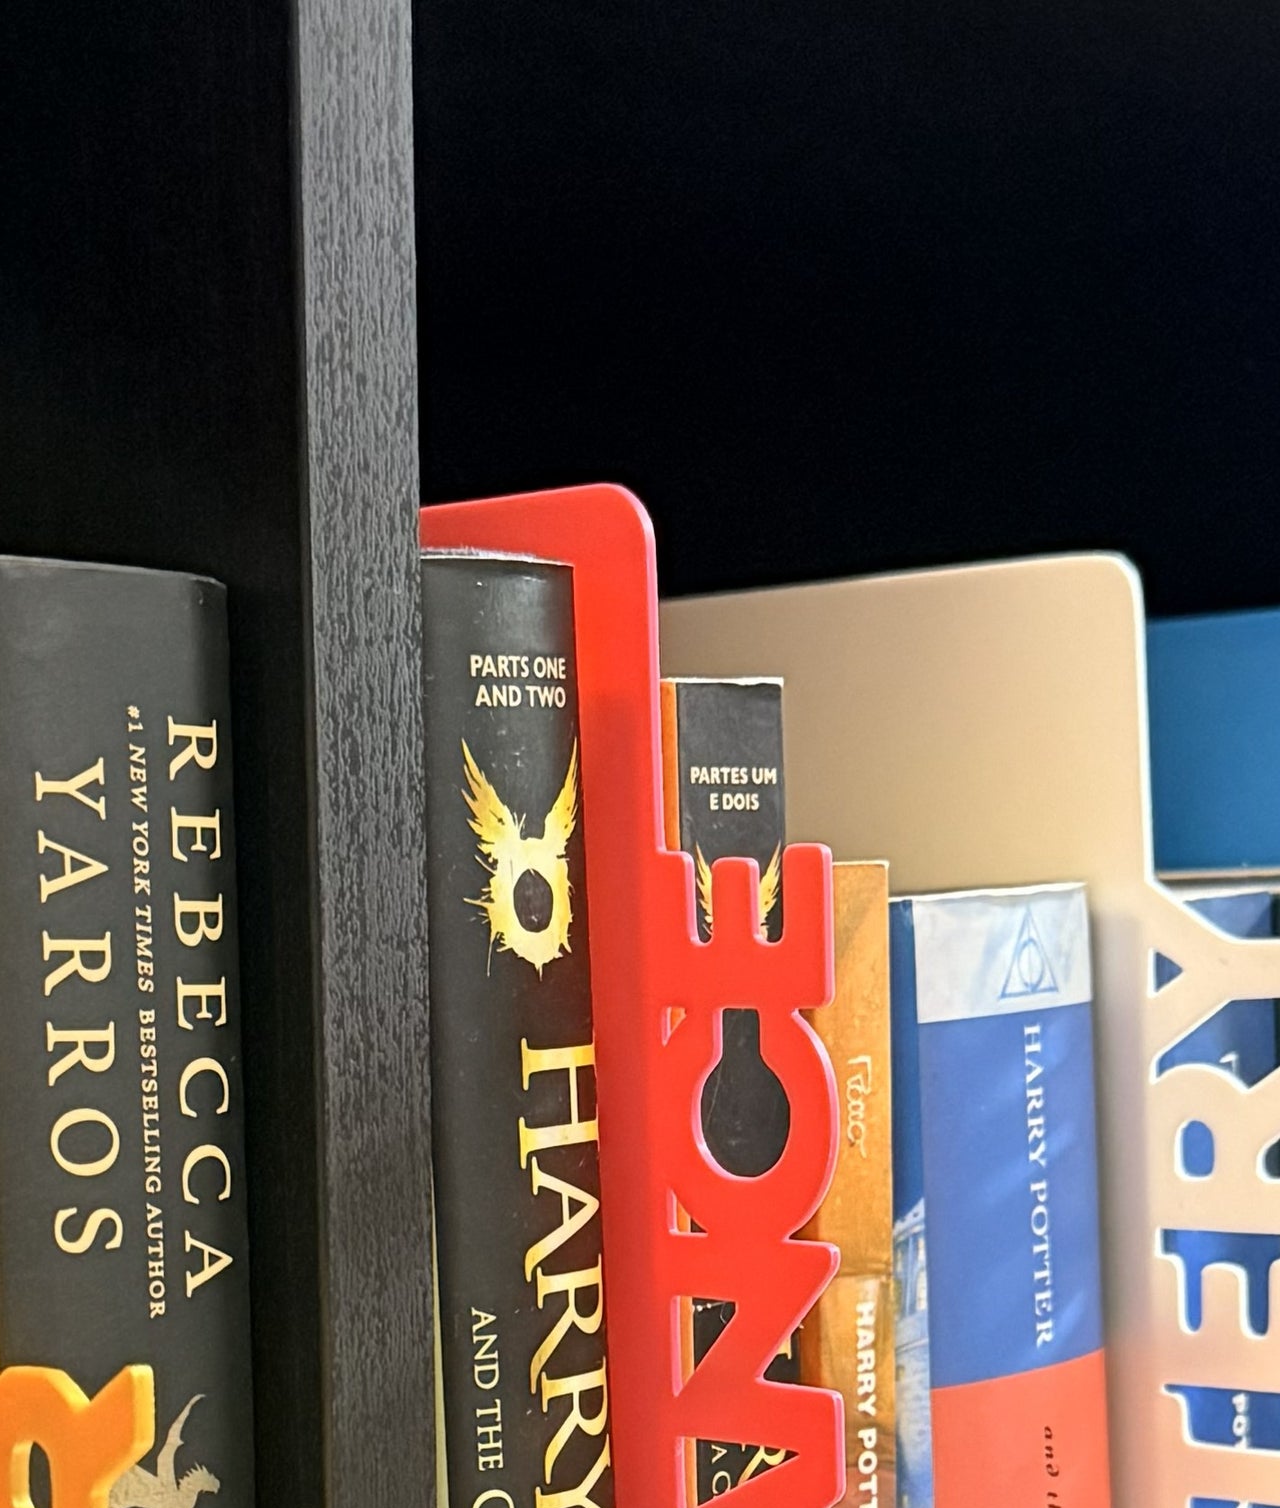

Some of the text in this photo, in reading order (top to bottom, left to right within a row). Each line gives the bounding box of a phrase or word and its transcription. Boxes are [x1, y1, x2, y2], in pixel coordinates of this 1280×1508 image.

[469, 655, 567, 680] PARTS ONE
[474, 685, 566, 709] AND TWO
[129, 742, 148, 814] NEW
[690, 766, 777, 785] PARTES UM
[709, 792, 760, 811] E DOIS
[132, 818, 151, 896] YORK
[134, 904, 155, 994] TIMES
[34, 758, 123, 1255] YARROS
[167, 715, 233, 1298] REBECCA
[139, 1009, 162, 1194] BESTSELLING
[1023, 1023, 1055, 1348] HARRY POTTER
[146, 1202, 166, 1319] AUTHOR
[470, 1306, 500, 1390] AND
[855, 1300, 878, 1416] HARRY
[475, 1398, 504, 1472] THE
[1043, 1424, 1060, 1479] and
